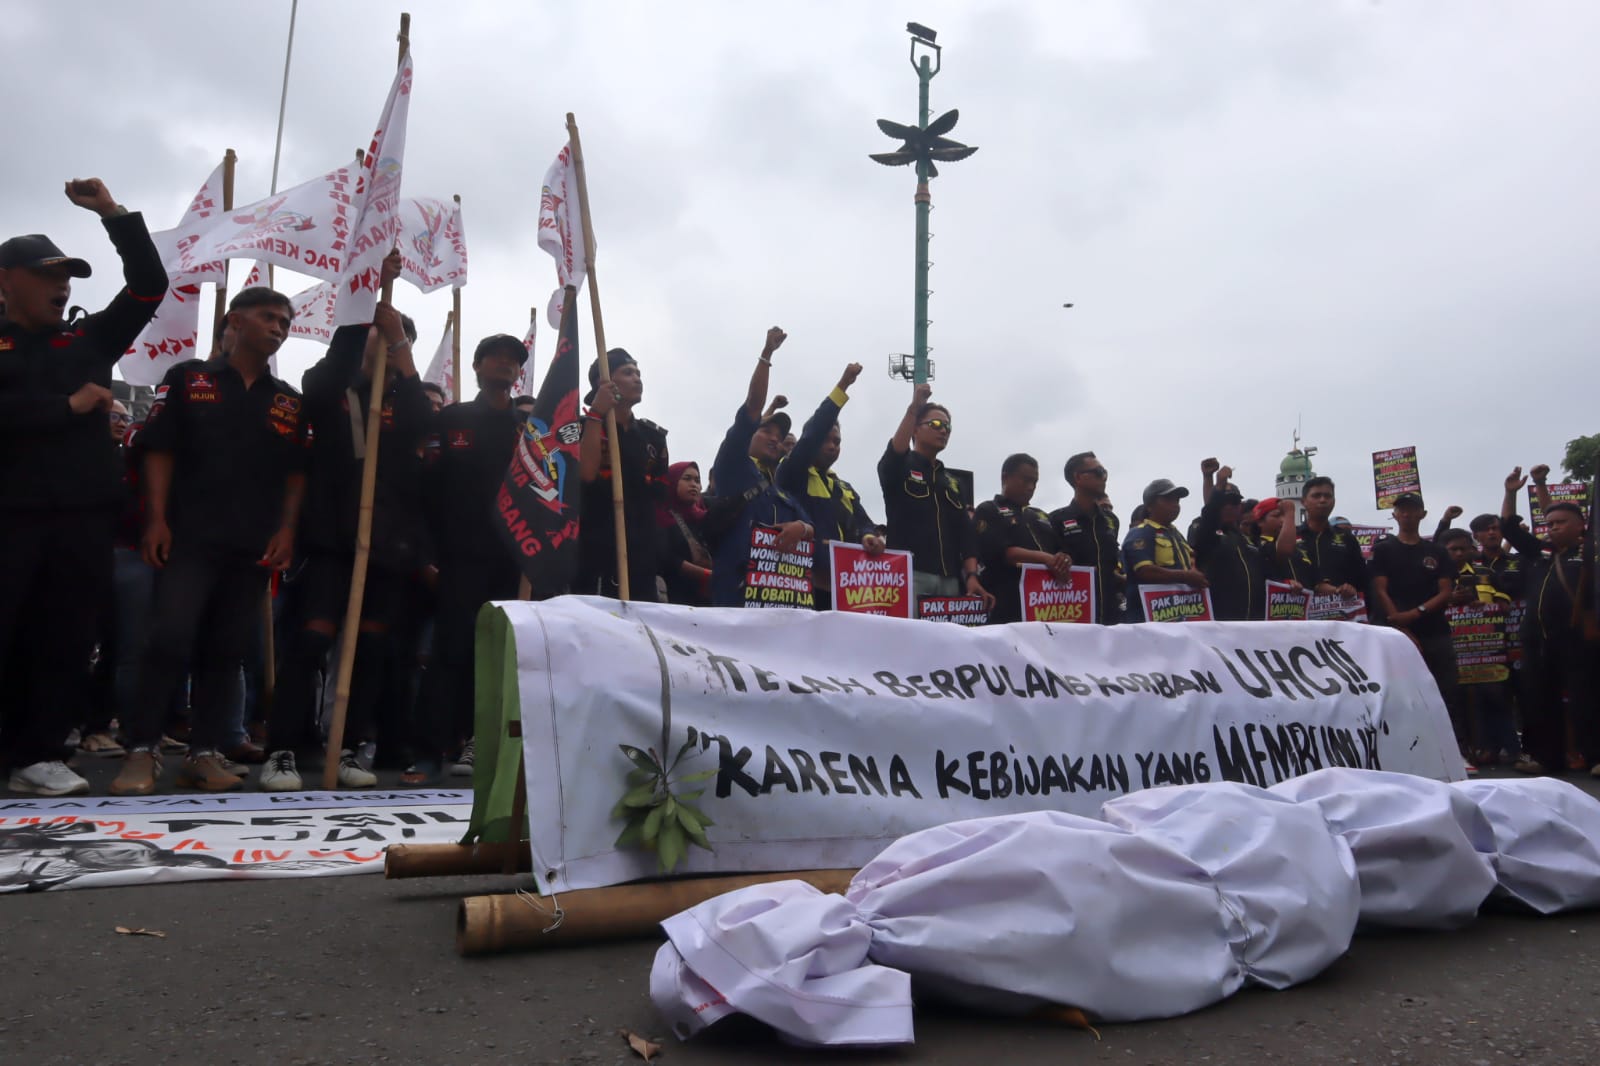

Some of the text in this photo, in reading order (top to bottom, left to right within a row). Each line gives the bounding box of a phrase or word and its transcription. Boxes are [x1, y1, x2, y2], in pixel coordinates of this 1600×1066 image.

[750, 547, 813, 569] WONG MRIANG
[853, 559, 891, 572] WONG
[757, 560, 804, 578] KUE KUDU
[751, 573, 809, 592] LANGSUNG
[839, 571, 905, 588] BANYUMAS
[745, 586, 758, 600] DI
[761, 587, 795, 603] OBATI
[845, 586, 900, 606] WARAS
[1028, 589, 1089, 607] BANYUMAS
[1151, 597, 1171, 610] PAK
[923, 600, 984, 613] PAK BUPATI
[1034, 603, 1083, 621] WARAS
[1152, 603, 1206, 622] BANYUMAS
[1086, 668, 1223, 699] KORBAN
[1135, 751, 1211, 790] YANG
